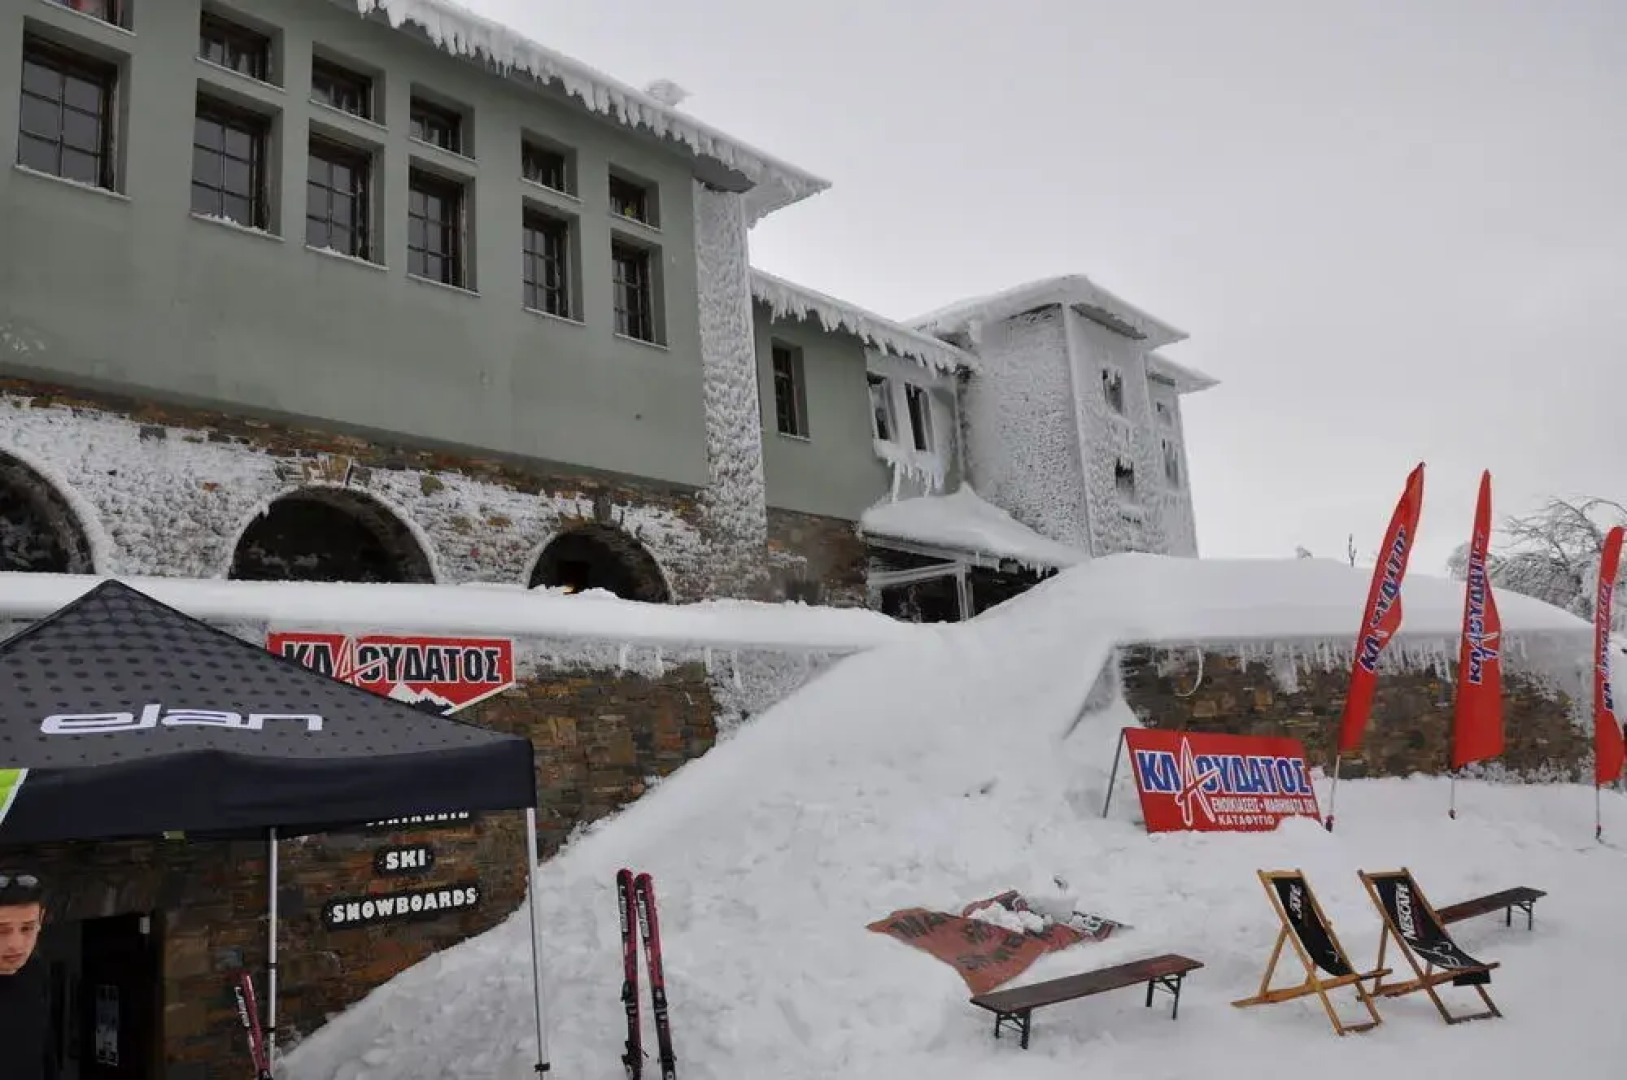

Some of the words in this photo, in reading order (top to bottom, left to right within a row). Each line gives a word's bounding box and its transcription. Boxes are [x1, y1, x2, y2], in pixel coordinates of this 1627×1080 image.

[40, 703, 322, 735] elan
[1135, 737, 1311, 826] ΚΛΑΟΥΔΑΤΟΣ
[386, 849, 426, 870] SKI
[332, 887, 476, 923] SNOWBOARDS
